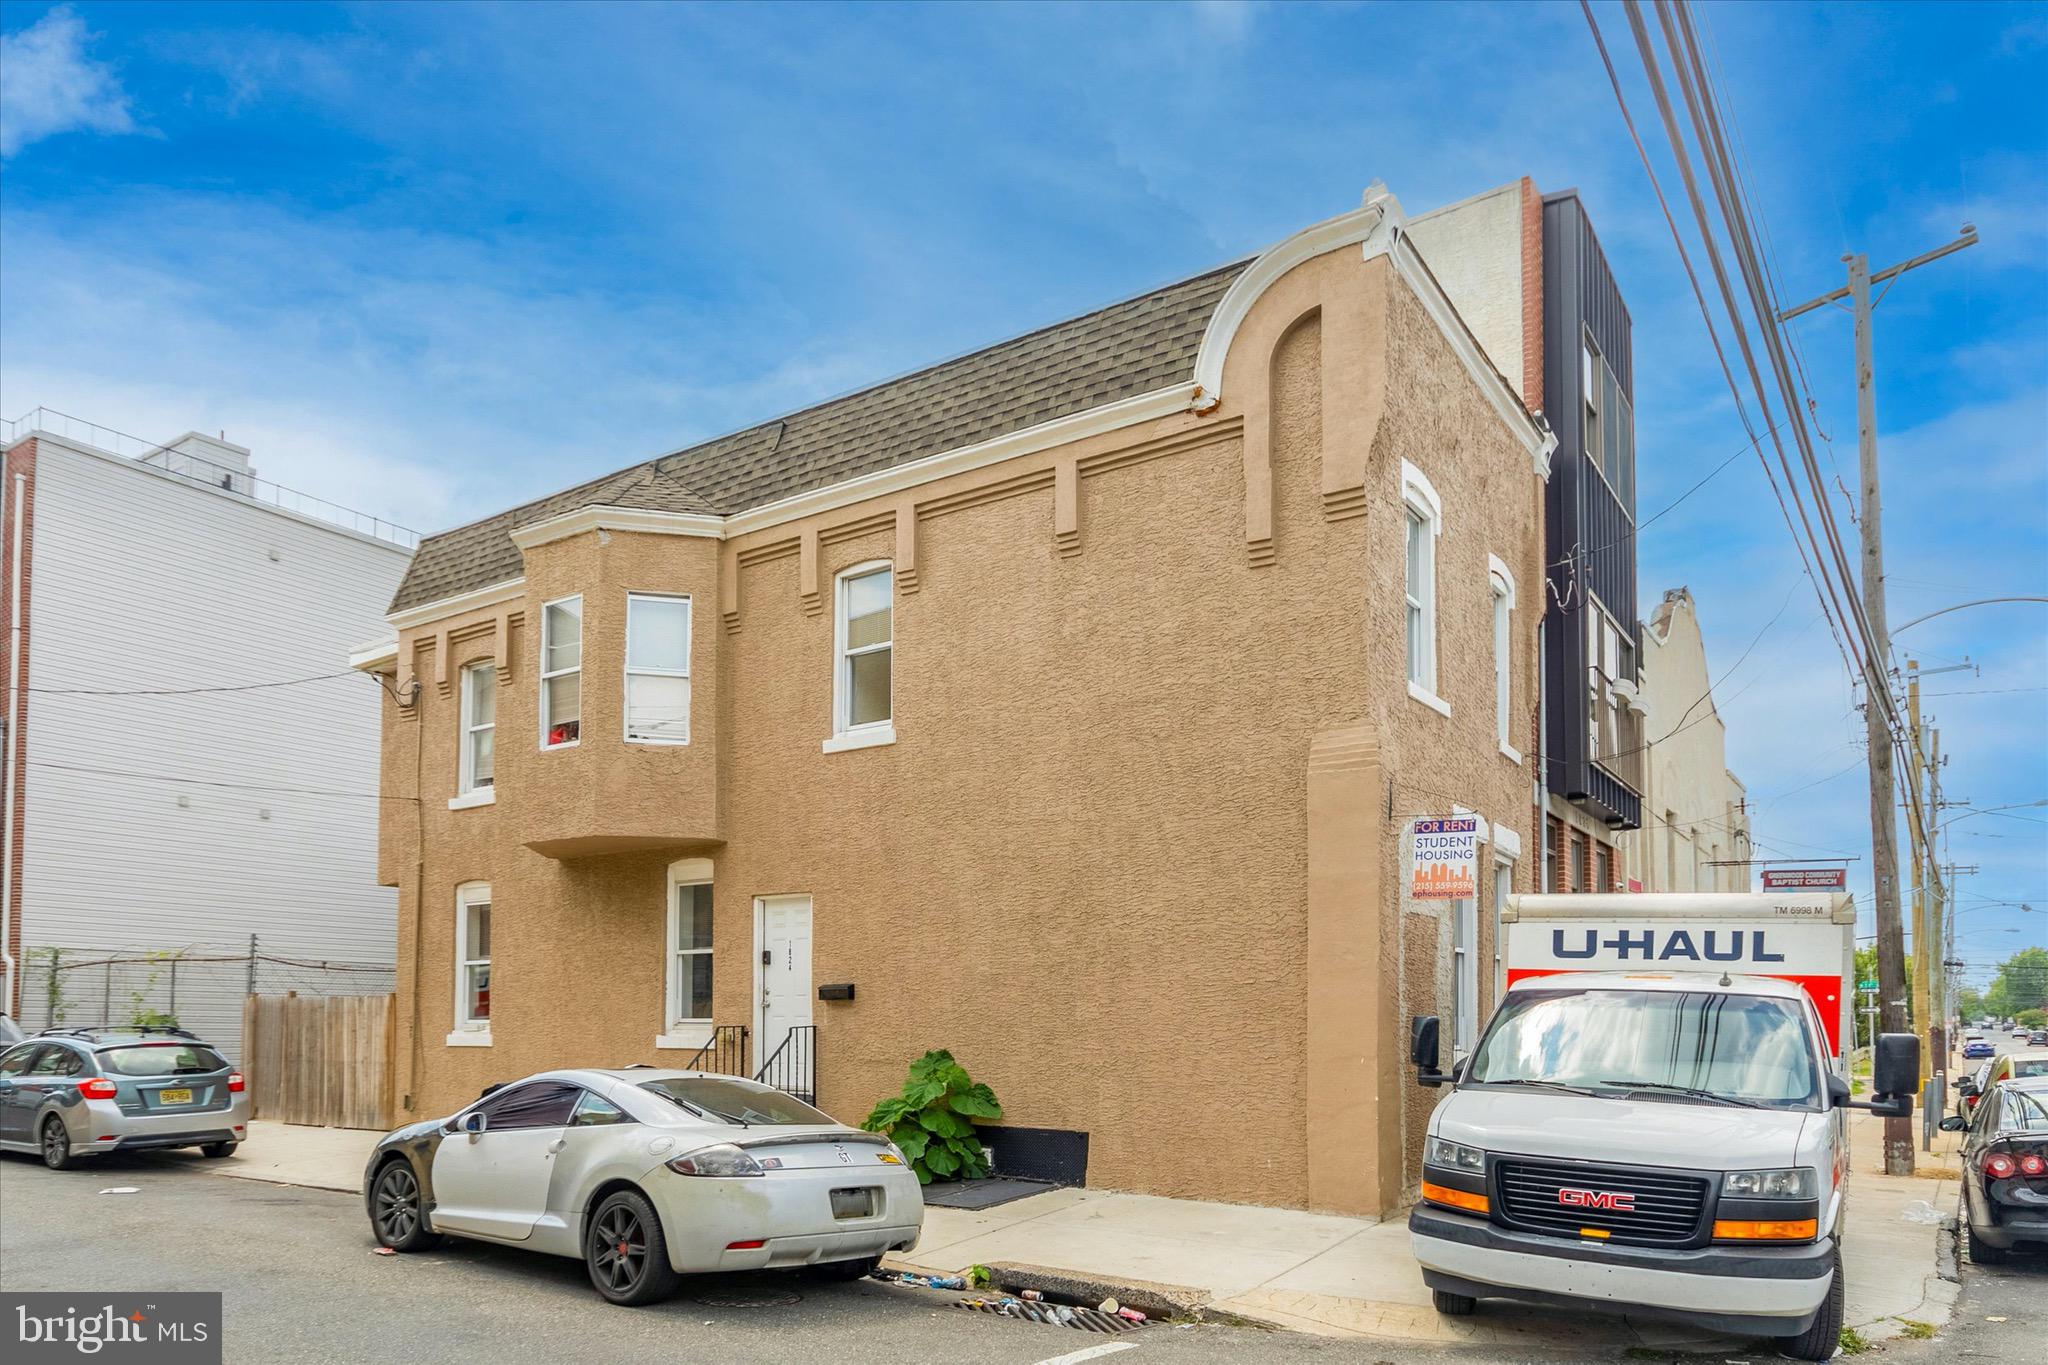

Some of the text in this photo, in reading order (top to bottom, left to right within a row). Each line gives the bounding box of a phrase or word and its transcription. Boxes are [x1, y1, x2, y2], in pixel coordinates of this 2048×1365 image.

[1415, 820, 1475, 833] FOR RENT
[1415, 836, 1474, 849] STUDENT
[1415, 850, 1474, 861] HOUSING
[1413, 881, 1433, 891] (215)
[1412, 889, 1473, 899] ephousing.com
[1773, 906, 1823, 914] TM 6998 M
[1559, 1188, 1635, 1211] GMC
